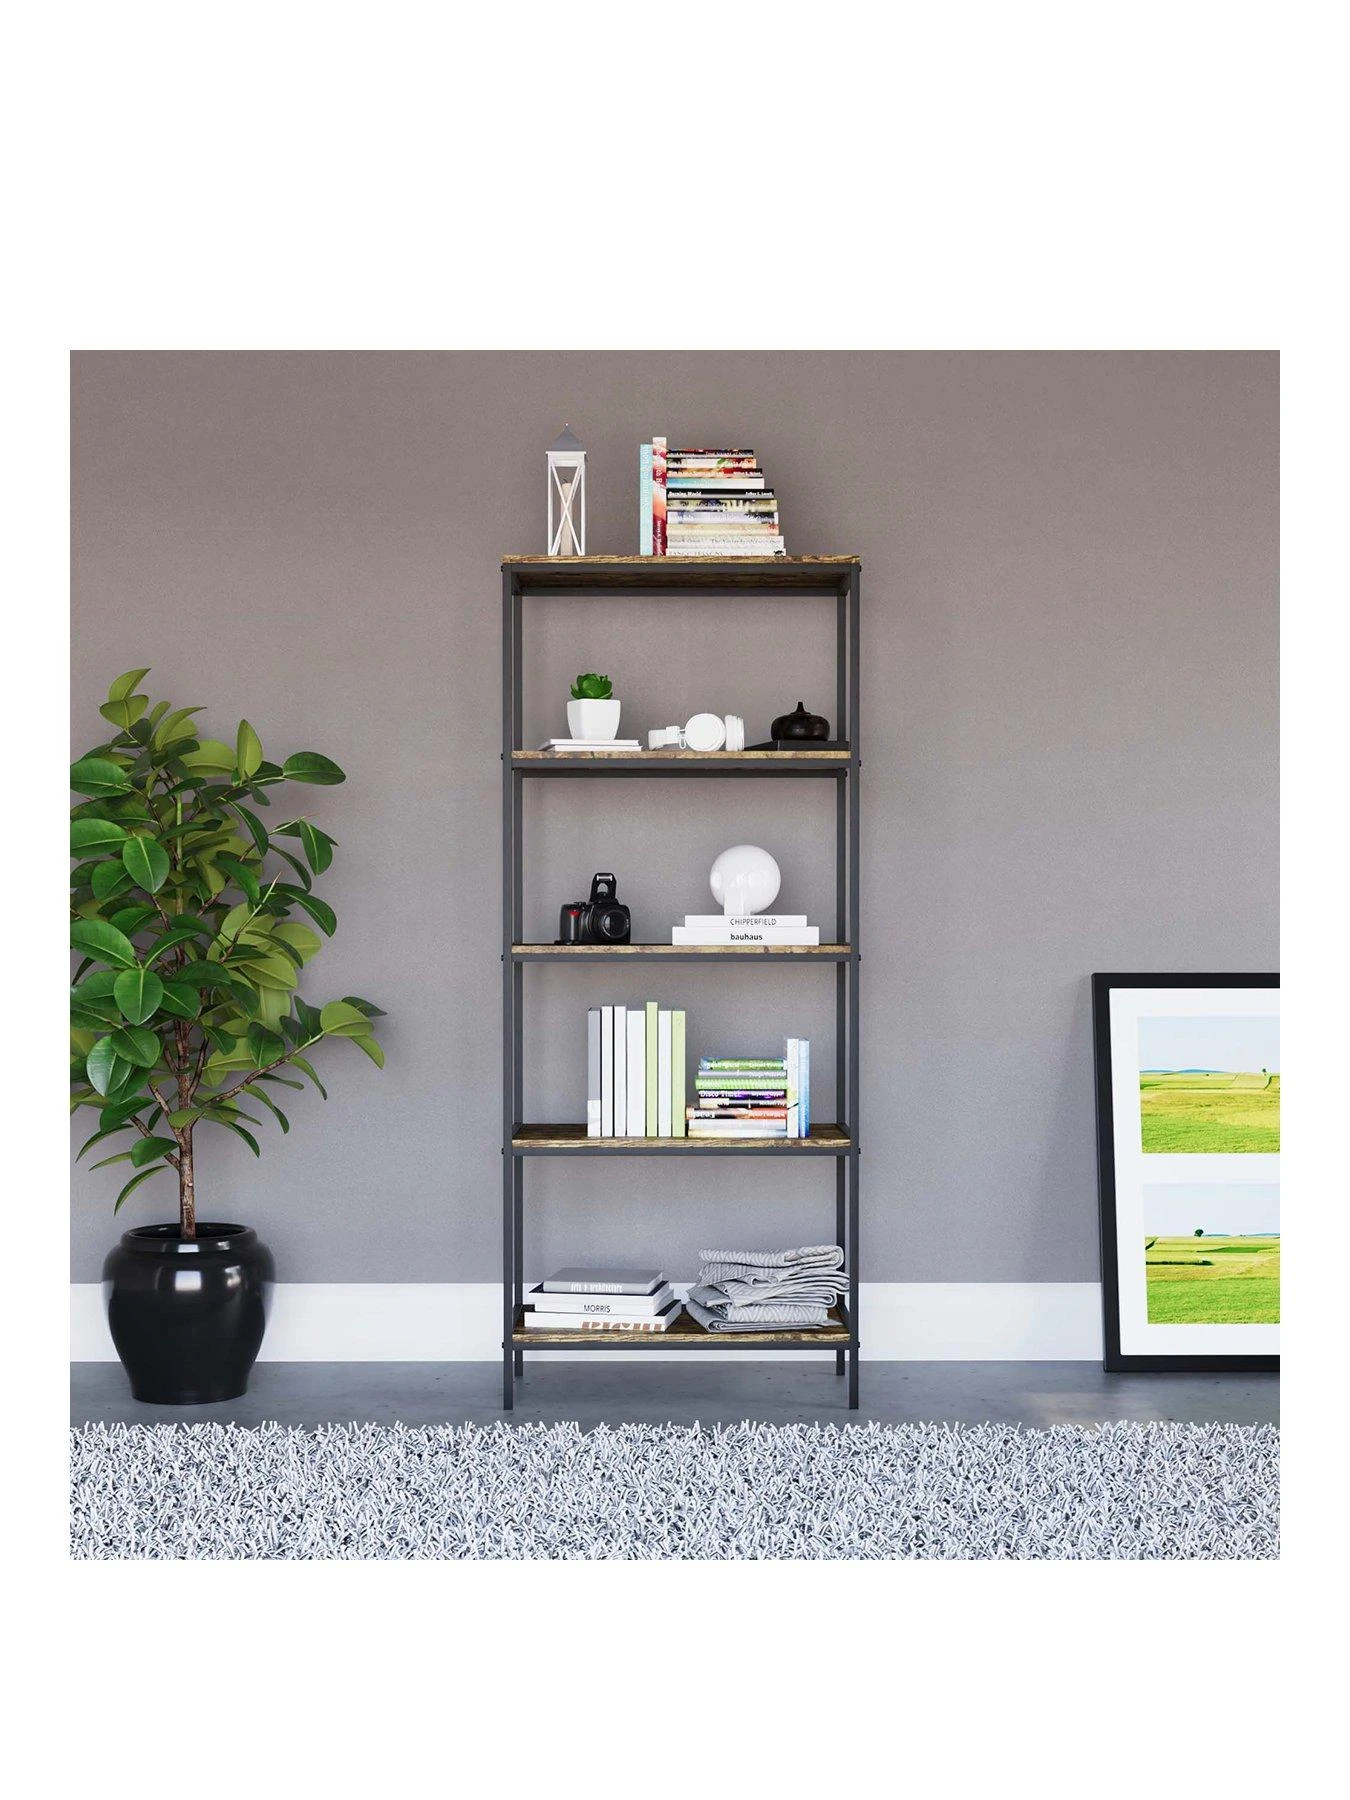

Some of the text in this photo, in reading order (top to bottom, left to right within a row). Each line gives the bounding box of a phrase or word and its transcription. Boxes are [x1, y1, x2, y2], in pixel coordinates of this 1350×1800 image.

[730, 918, 777, 926] CHIPPERFIELD
[730, 933, 763, 941] bauhaus
[583, 1304, 611, 1313] MORRIS
